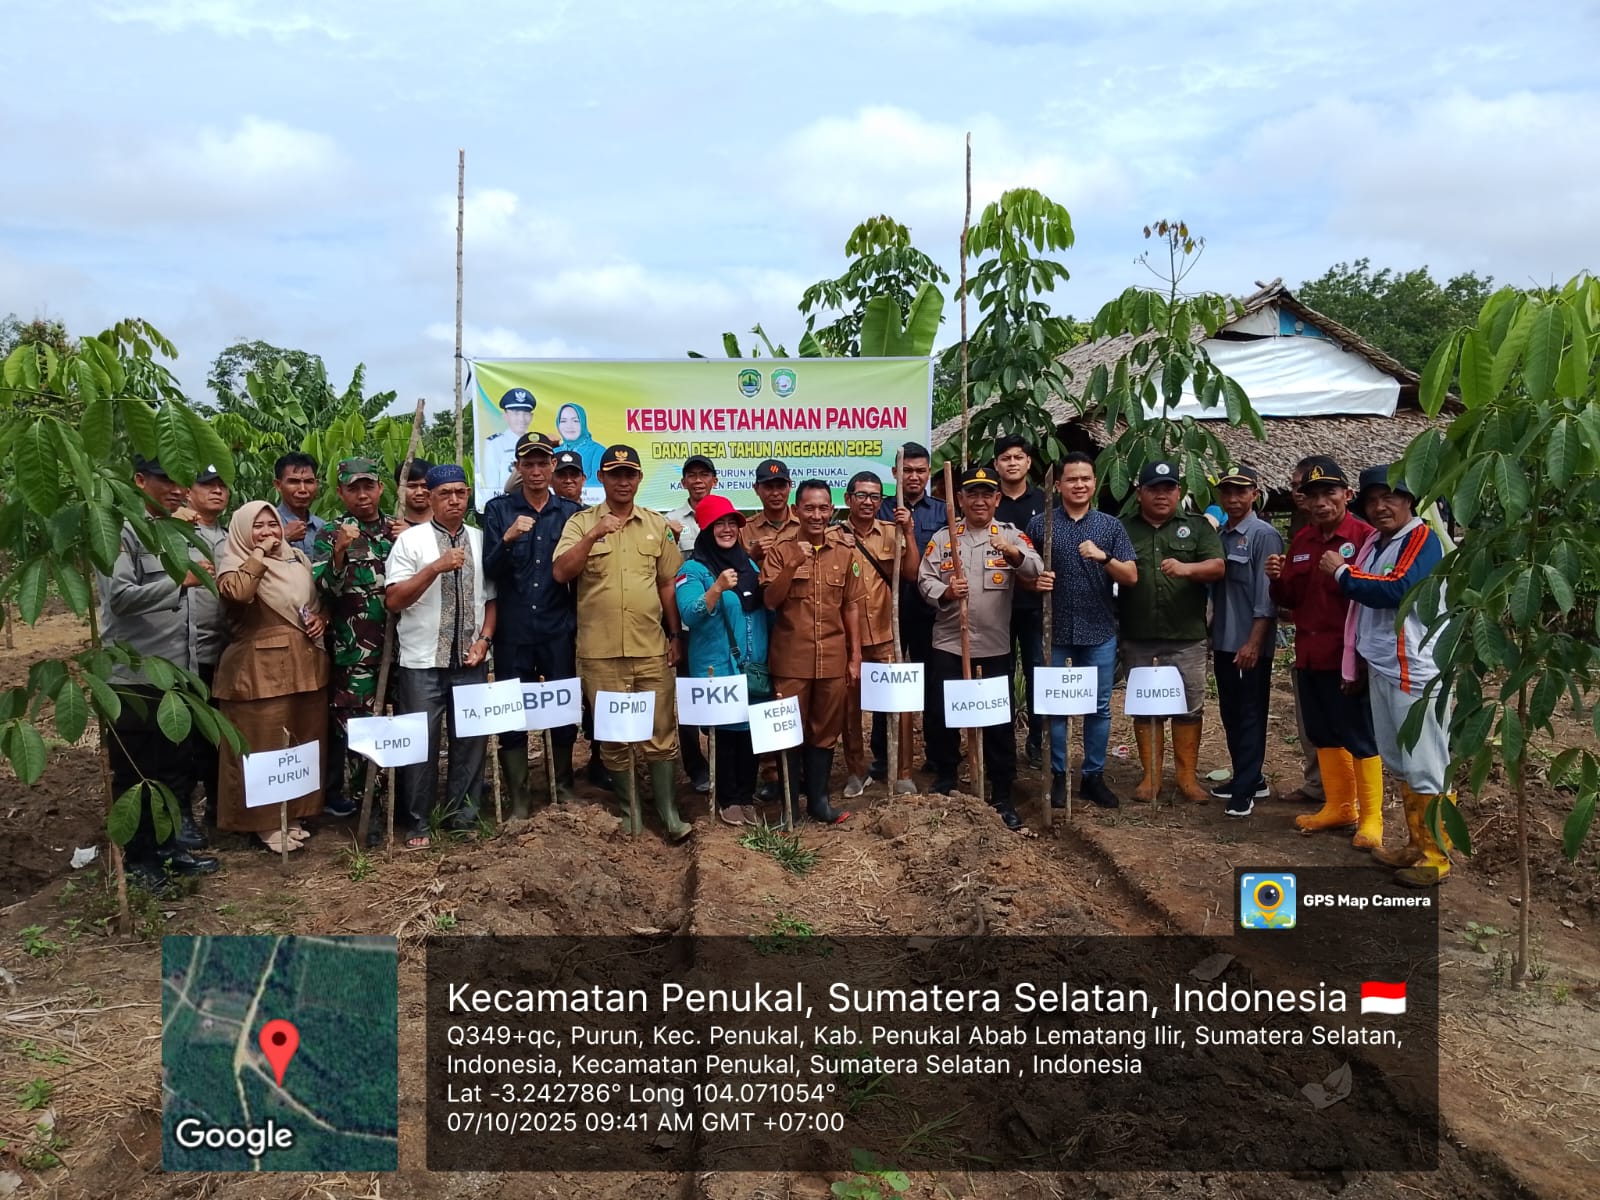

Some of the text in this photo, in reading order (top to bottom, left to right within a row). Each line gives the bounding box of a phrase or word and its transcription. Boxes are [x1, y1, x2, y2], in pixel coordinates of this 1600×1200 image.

[626, 406, 907, 432] KEBUN KETAHANAN PANGAN
[652, 440, 883, 459] DANA DESA TAHUN ANGGARAN 2025
[716, 468, 746, 478] PURUN
[806, 468, 848, 477] PENUKAL
[870, 670, 919, 683] CAMAT
[1062, 673, 1083, 684] BPP
[522, 688, 572, 710] BPD
[691, 684, 739, 705] PKK
[1045, 688, 1094, 699] PENUKAL
[1136, 687, 1181, 698] BUMDES
[462, 701, 523, 720] TA, PD/PLD
[609, 700, 647, 714] DPMD
[951, 697, 1010, 711] KAPOLSEK
[764, 704, 798, 719] KEPALA
[773, 719, 797, 733] DESA
[374, 737, 411, 751] LPMD
[278, 754, 302, 767] PPL
[268, 767, 310, 786] PURUN
